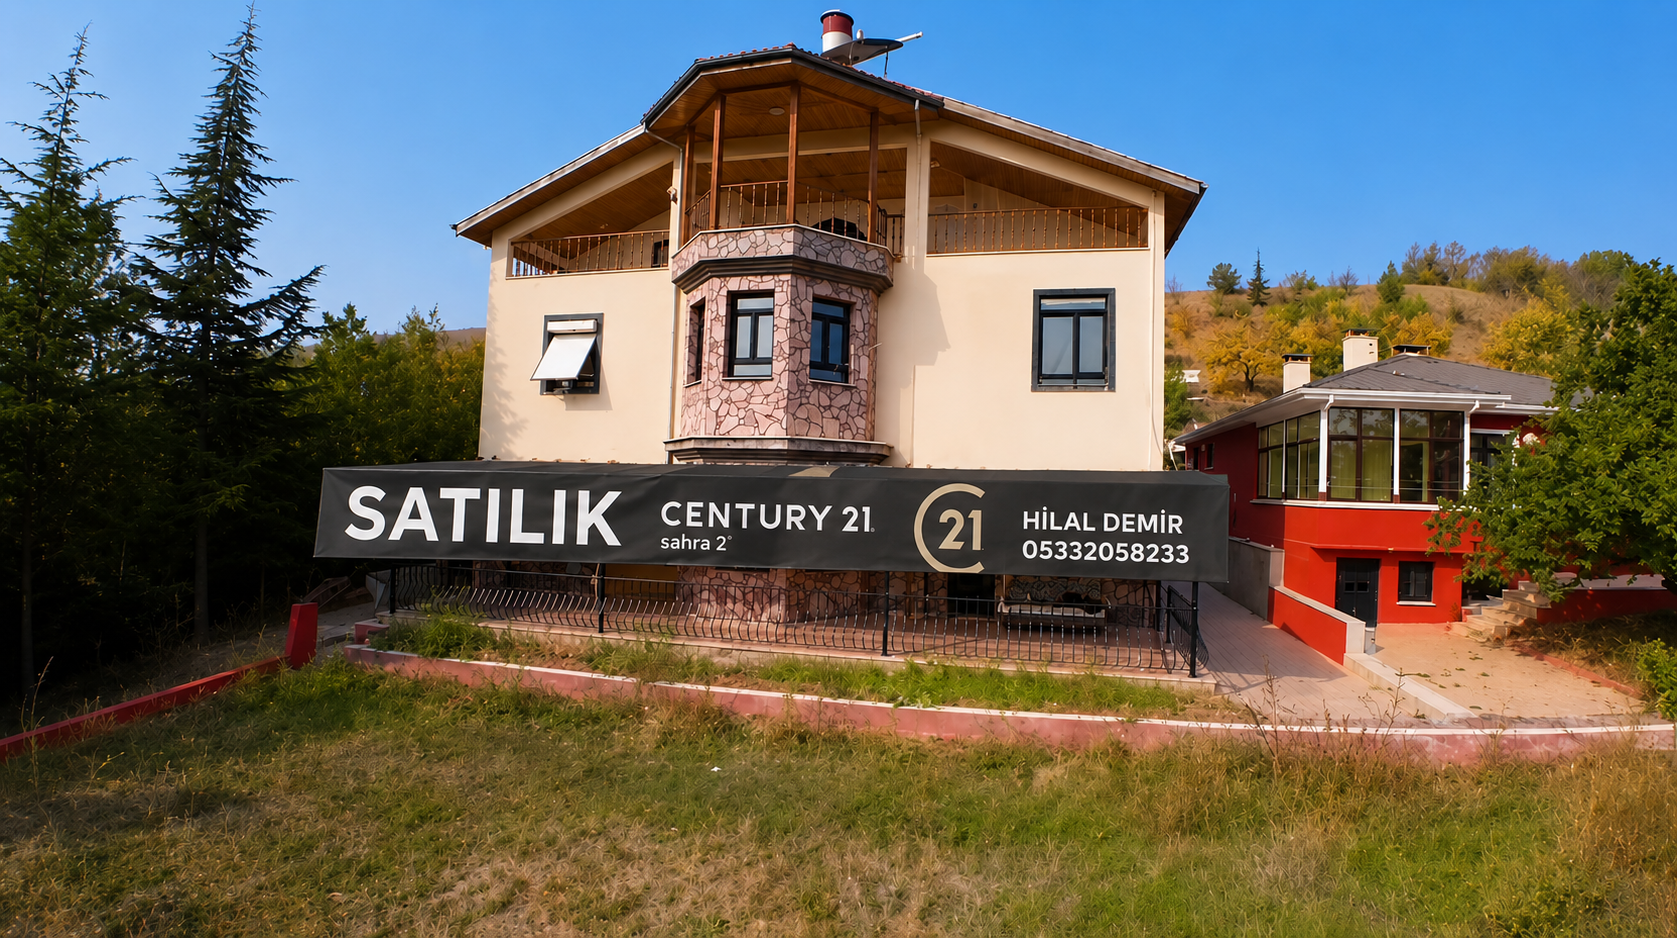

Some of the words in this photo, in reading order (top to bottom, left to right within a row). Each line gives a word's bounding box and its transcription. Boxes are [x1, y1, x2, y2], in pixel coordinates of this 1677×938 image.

[344, 485, 622, 547] SATILIK
[660, 501, 833, 531] CENTURY
[938, 508, 983, 551] 21
[1022, 506, 1096, 532] HİLAL
[1103, 509, 1184, 535] DEMİR
[660, 533, 711, 551] sahra
[1022, 539, 1190, 564] 05332058233
